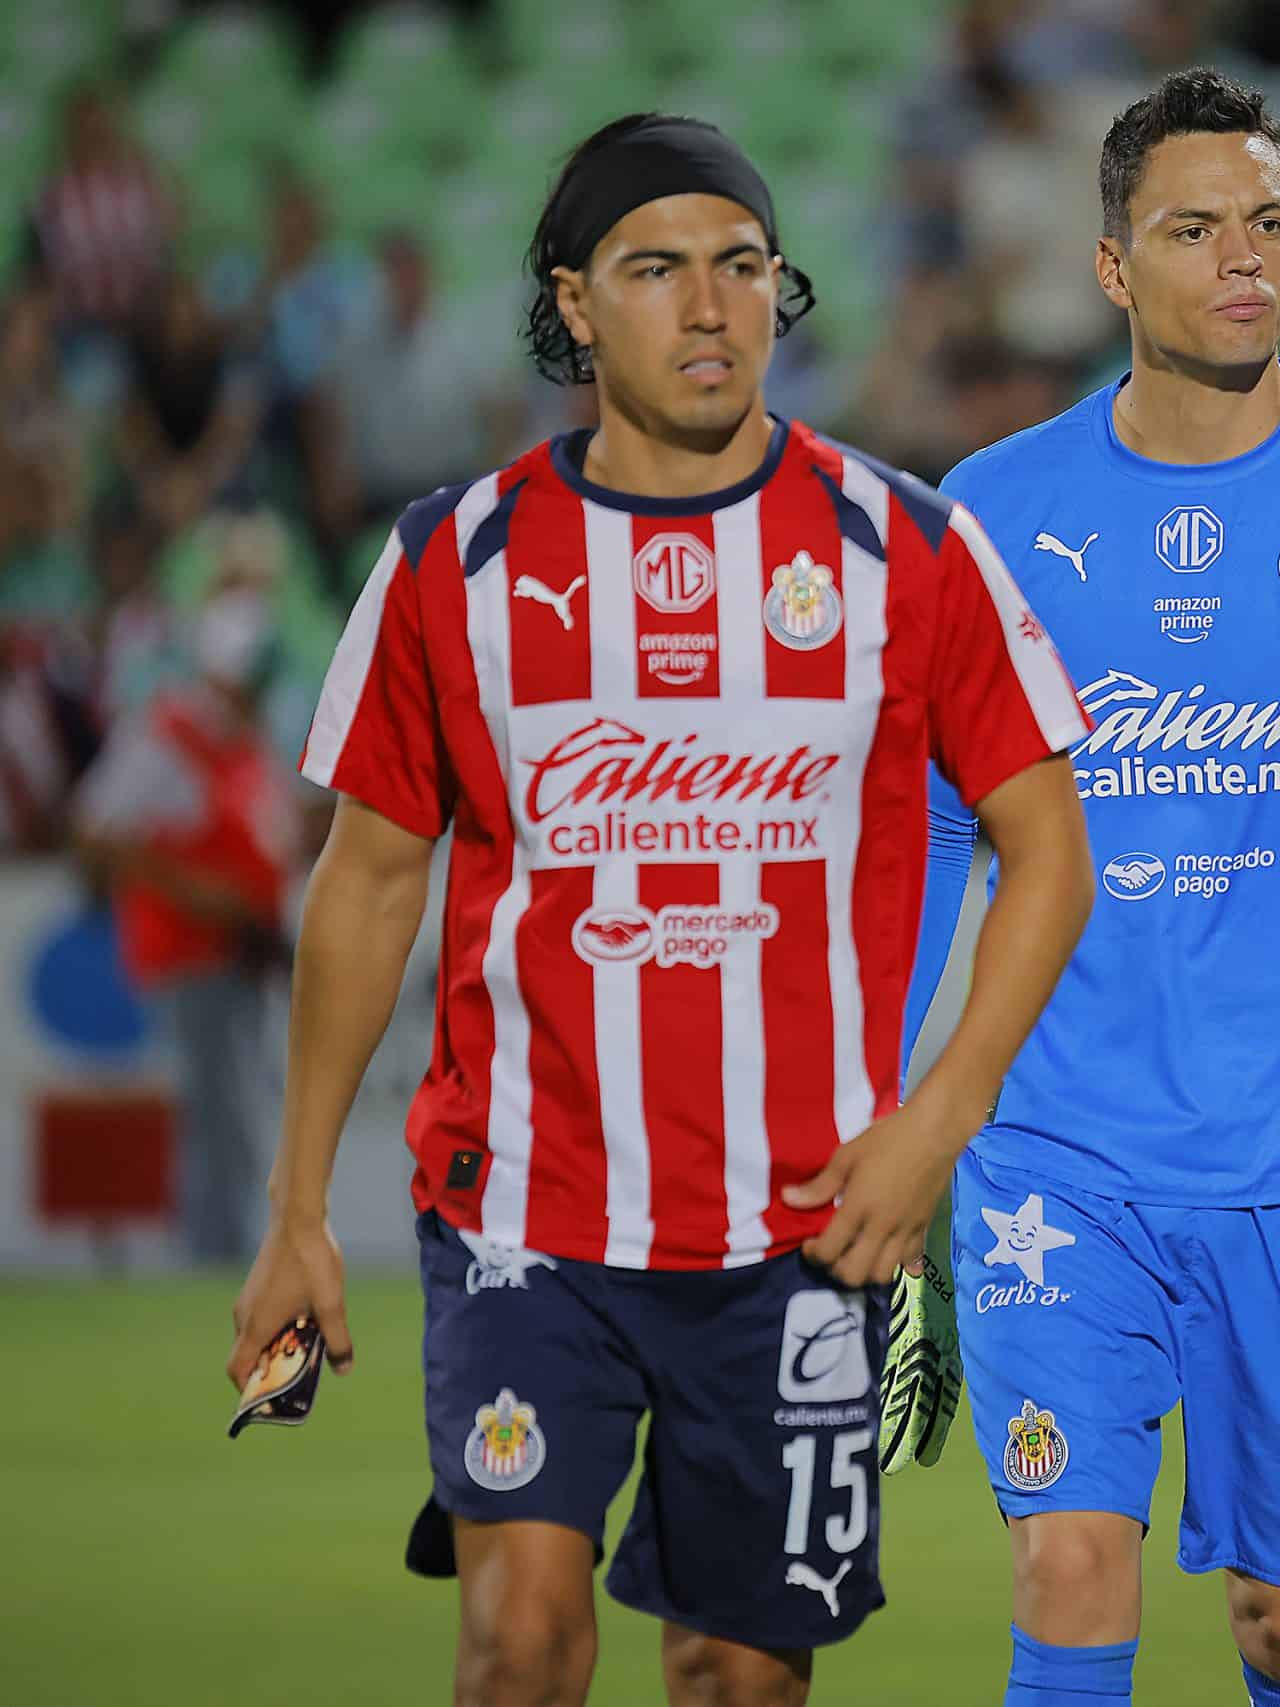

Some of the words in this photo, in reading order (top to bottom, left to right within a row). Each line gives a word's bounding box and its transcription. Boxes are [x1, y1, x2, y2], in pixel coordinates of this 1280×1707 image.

[1161, 511, 1218, 567] MG
[642, 542, 708, 604] MG
[1153, 596, 1221, 612] amazon
[1160, 613, 1214, 633] prime
[639, 633, 716, 651] amazon
[648, 652, 708, 673] prime
[518, 717, 842, 824] Caliente
[550, 811, 819, 855] caliente.mx
[1175, 847, 1275, 872] mercado
[1174, 875, 1230, 899] pago
[664, 912, 770, 931] mercado
[664, 938, 728, 960] pago
[782, 1428, 873, 1554] 15
